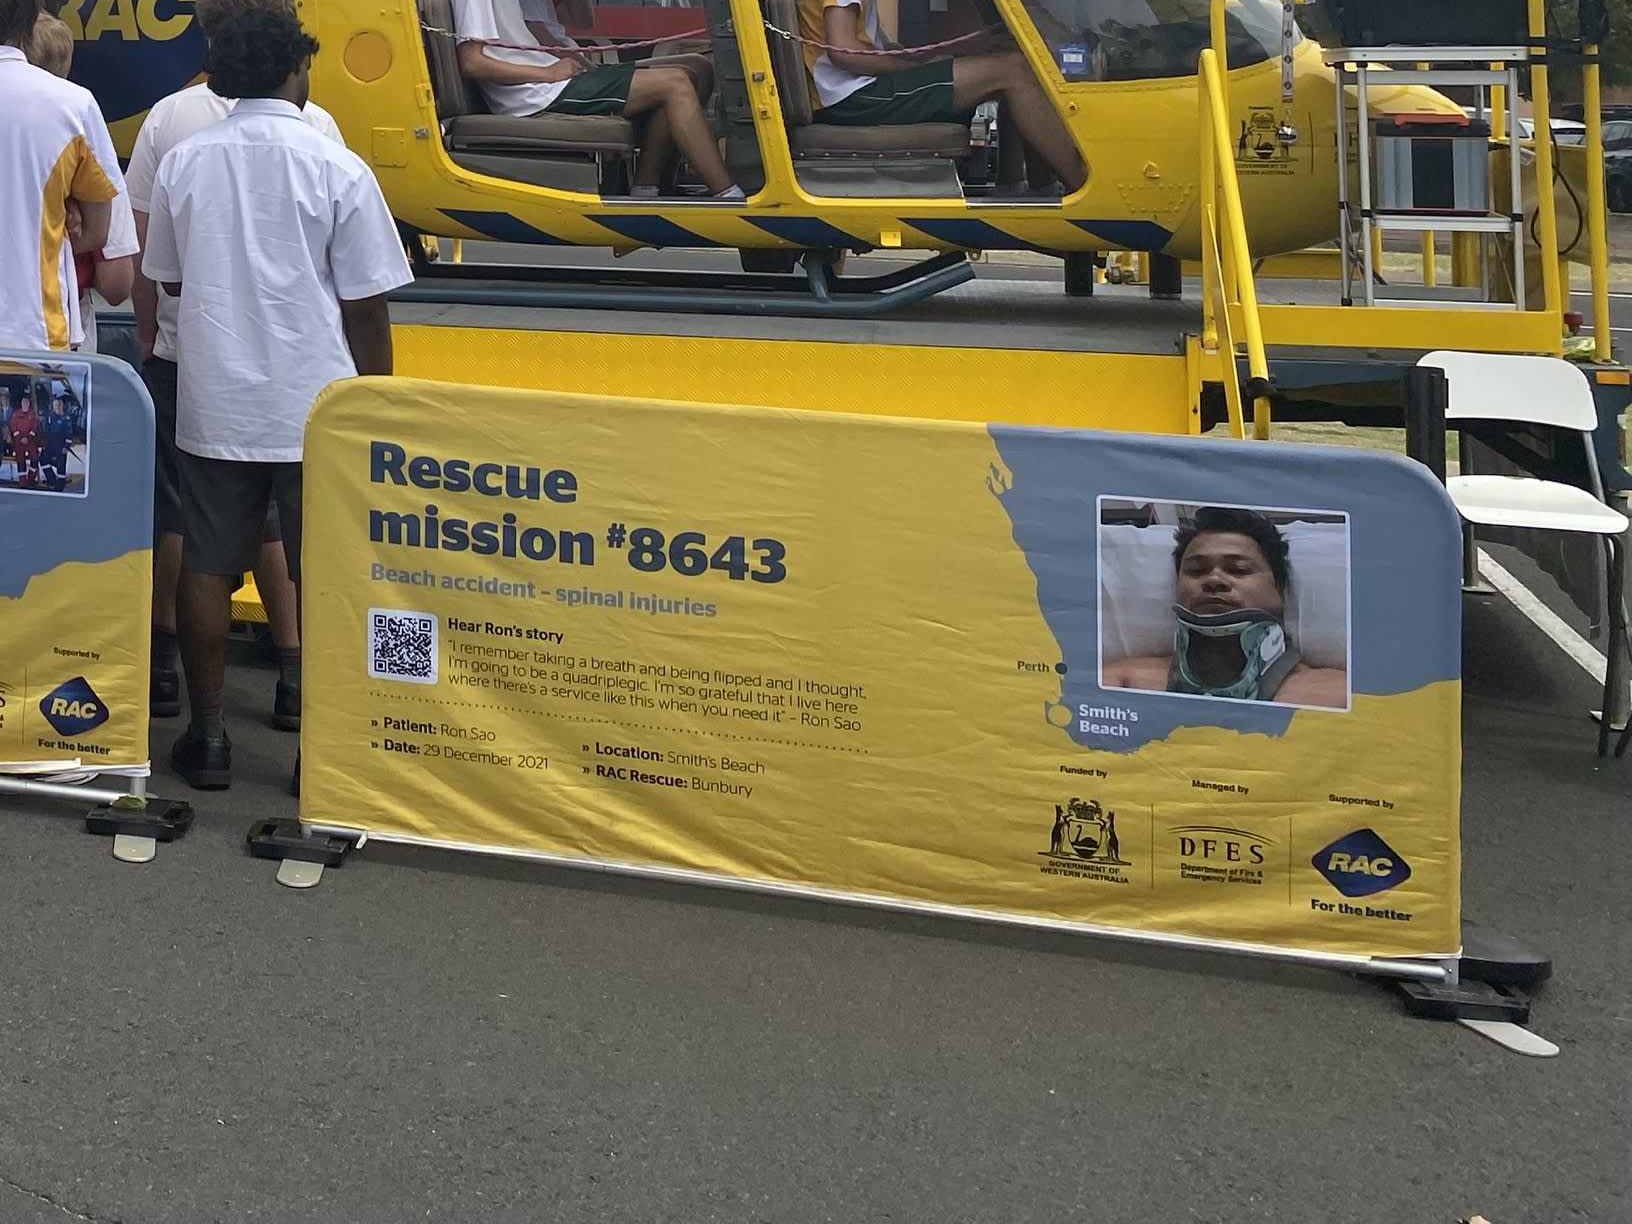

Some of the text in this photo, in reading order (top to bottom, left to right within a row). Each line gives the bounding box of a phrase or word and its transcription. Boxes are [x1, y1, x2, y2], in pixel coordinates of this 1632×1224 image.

[370, 440, 578, 503] Rescue
[369, 504, 786, 584] mission #8643
[372, 562, 716, 617] Beach accident spinal injuries
[448, 617, 564, 644] Hear Ron's story
[53, 646, 100, 660] Supported by
[460, 641, 530, 662] remember
[534, 651, 574, 669] taking
[579, 658, 586, 668] a
[592, 656, 635, 674] breath
[640, 662, 666, 677] and
[670, 666, 710, 684] being
[714, 670, 761, 687] flipped
[766, 677, 793, 690] and
[1017, 660, 1050, 673] Perth
[448, 656, 858, 714] I'm going to be a quadriplegic. I'm so grateful that live here
[51, 698, 97, 719] RAC
[448, 673, 489, 688] where
[494, 678, 536, 694] there's
[539, 686, 548, 696] a
[552, 688, 600, 702] service
[604, 691, 626, 705] like
[630, 694, 655, 708] this
[659, 698, 698, 713] when
[702, 703, 728, 717] you
[733, 706, 768, 721] need
[801, 712, 830, 728] Ron
[834, 716, 862, 731] Sao
[1079, 704, 1138, 722] Smith's
[383, 716, 496, 742] Patient: Ron Sao
[1079, 720, 1130, 737] Beach
[38, 738, 110, 756] For the better
[383, 739, 549, 770] Date: 29 December 2021
[596, 742, 766, 774] Location: Smith's Beach
[596, 764, 753, 798] RAC Rescue: Bunbury
[1060, 765, 1108, 779] Funded by
[1192, 779, 1249, 795] Managed by
[1328, 794, 1394, 810] Supported by
[1180, 836, 1264, 864] DFES
[1040, 866, 1129, 884] WESTERN AUSTRALIA
[1048, 860, 1107, 873] GOVERNMENT
[1180, 862, 1256, 877] Department of Fire
[1328, 852, 1393, 877] RAC
[1180, 872, 1262, 885] Emergency Services
[1311, 898, 1413, 921] For the better
